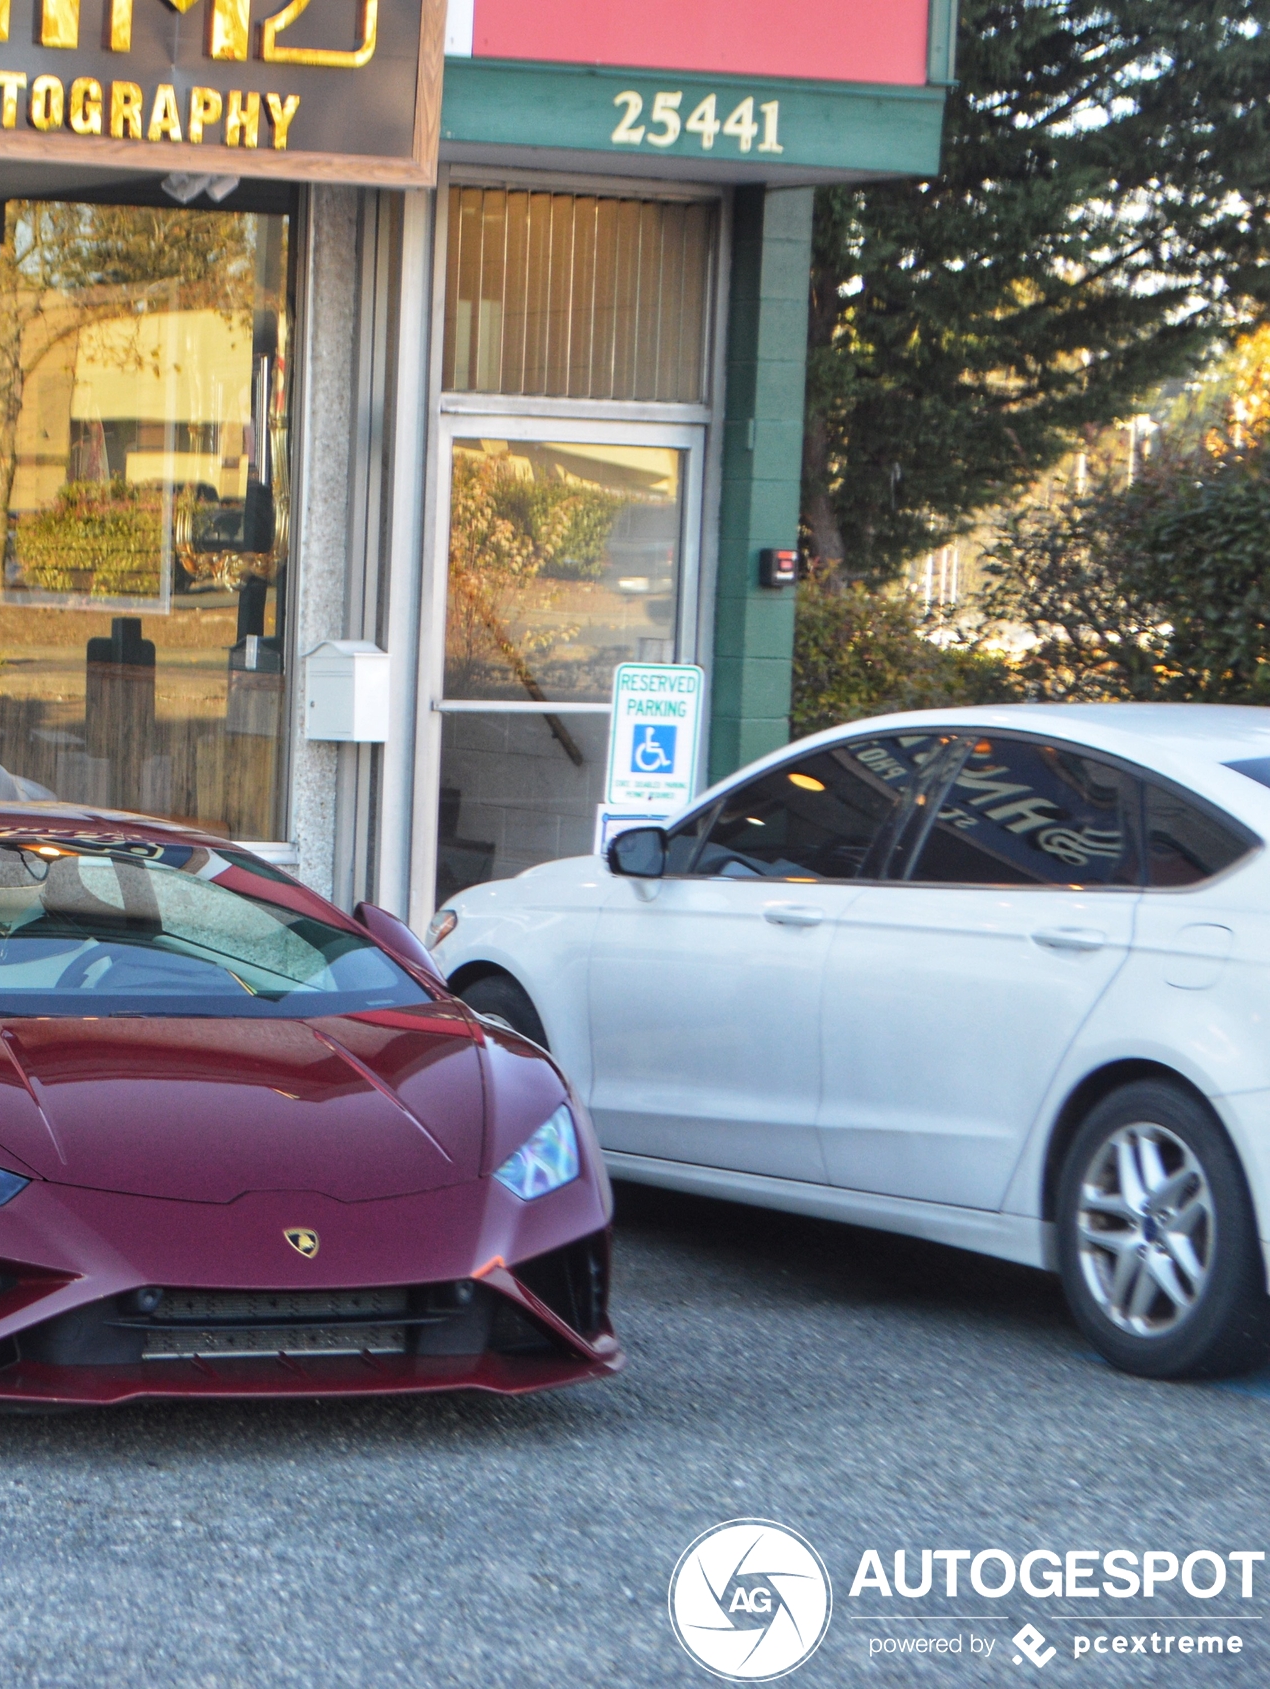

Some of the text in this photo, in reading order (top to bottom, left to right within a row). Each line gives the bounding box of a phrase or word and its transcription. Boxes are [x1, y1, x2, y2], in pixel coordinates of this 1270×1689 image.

[611, 90, 784, 154] 25441
[620, 673, 697, 693] RESERVED
[626, 698, 688, 718] PARKING
